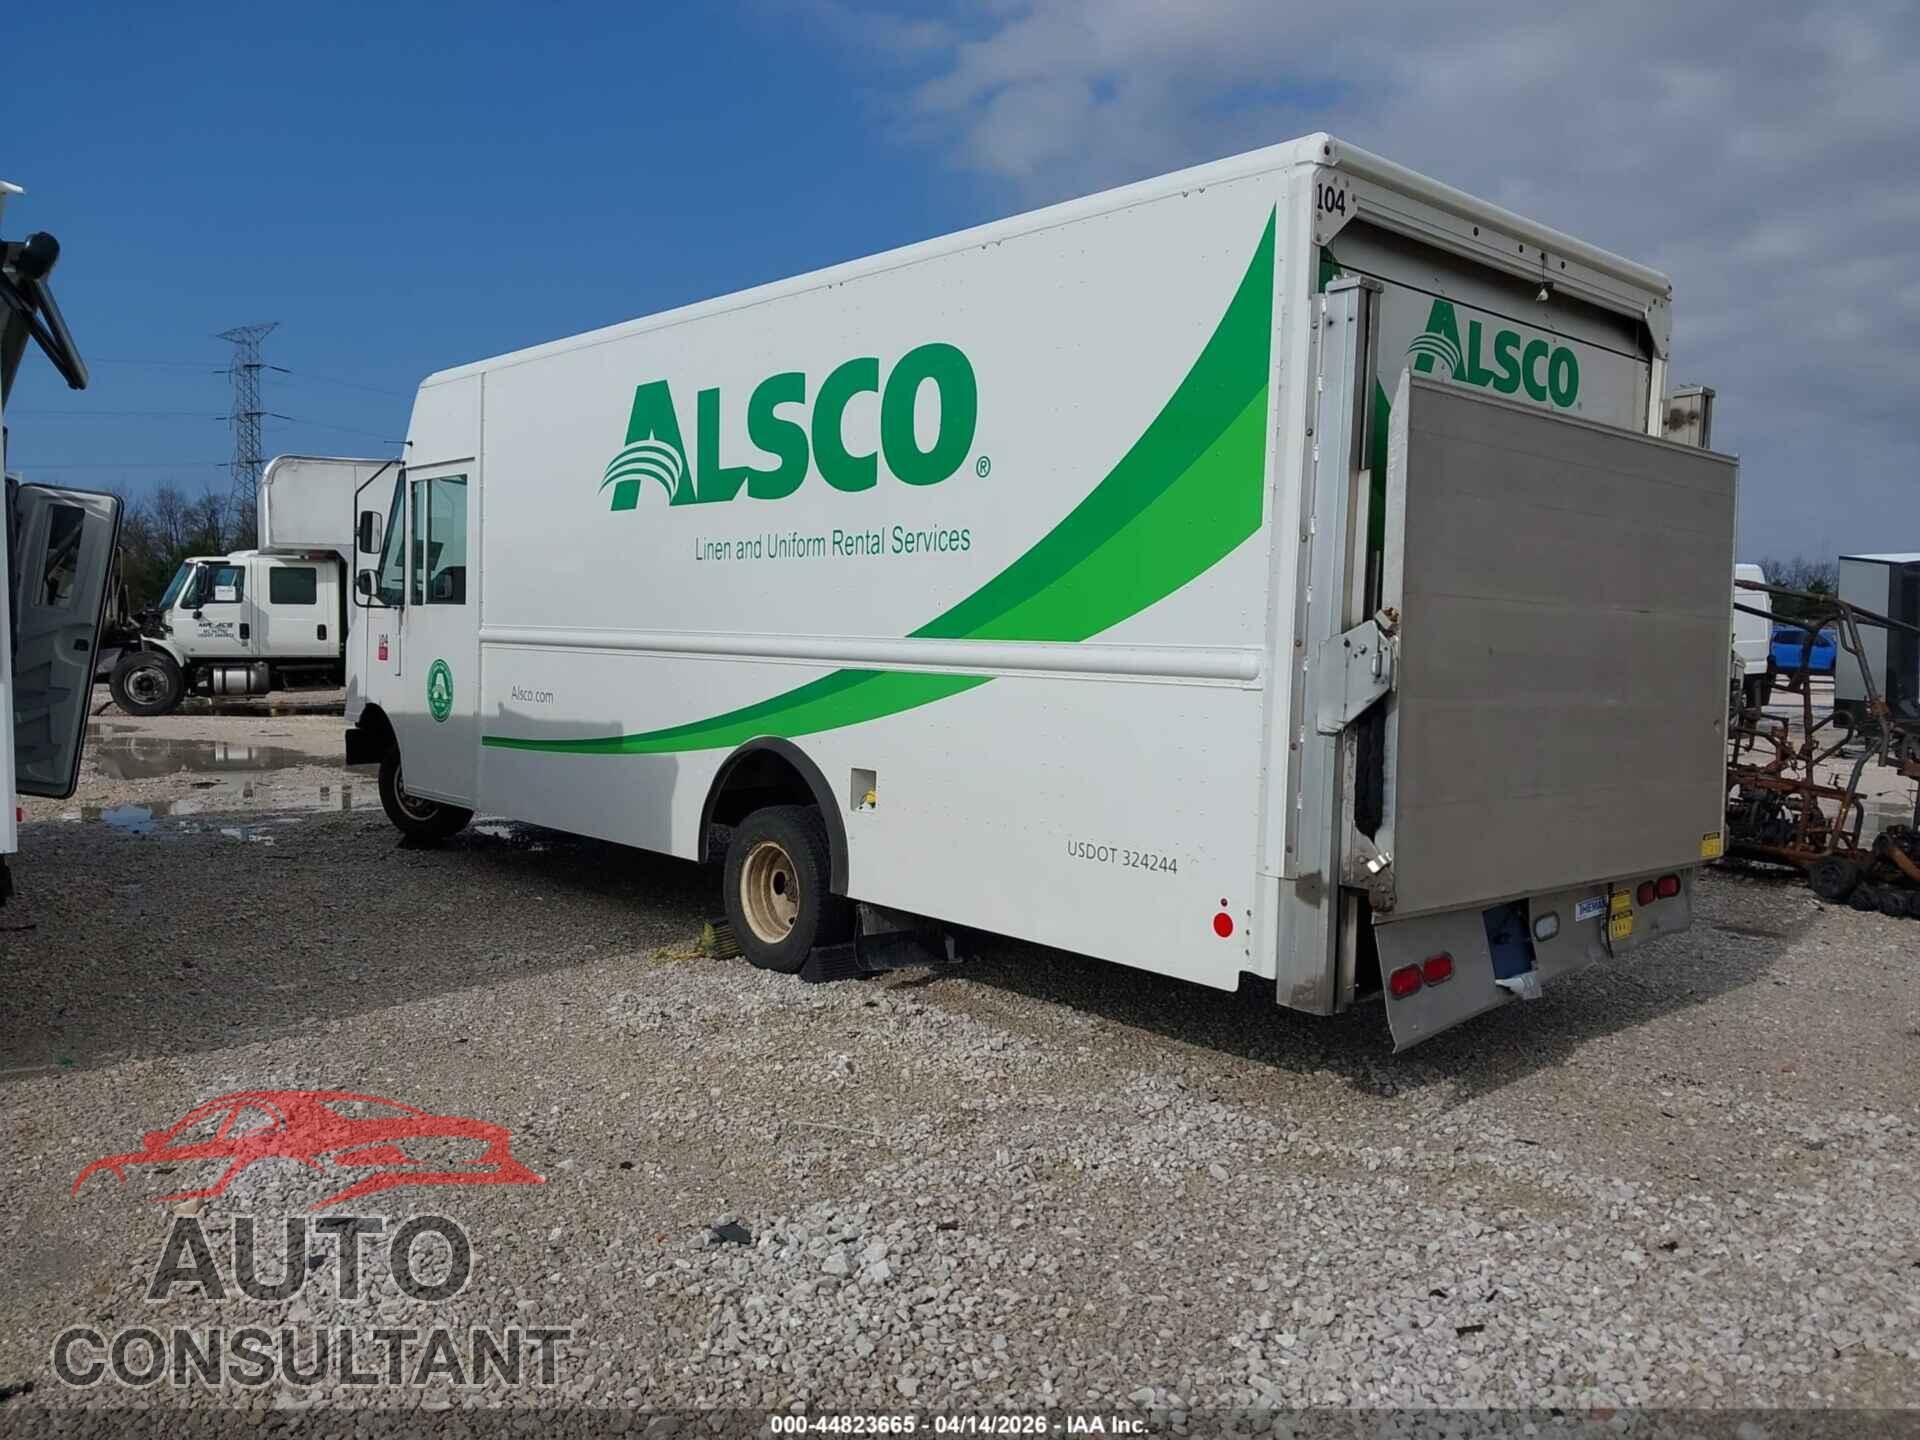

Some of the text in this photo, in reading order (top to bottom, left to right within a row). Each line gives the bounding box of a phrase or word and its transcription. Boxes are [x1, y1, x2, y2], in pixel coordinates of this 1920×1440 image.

[1317, 182, 1346, 216] 104
[1405, 299, 1579, 408] ALSCO
[598, 343, 978, 511] ALSCO
[695, 524, 971, 560] Linen and Uniform Rental Services
[511, 685, 554, 704] Alsco.com
[1067, 840, 1178, 874] USDOT 324244
